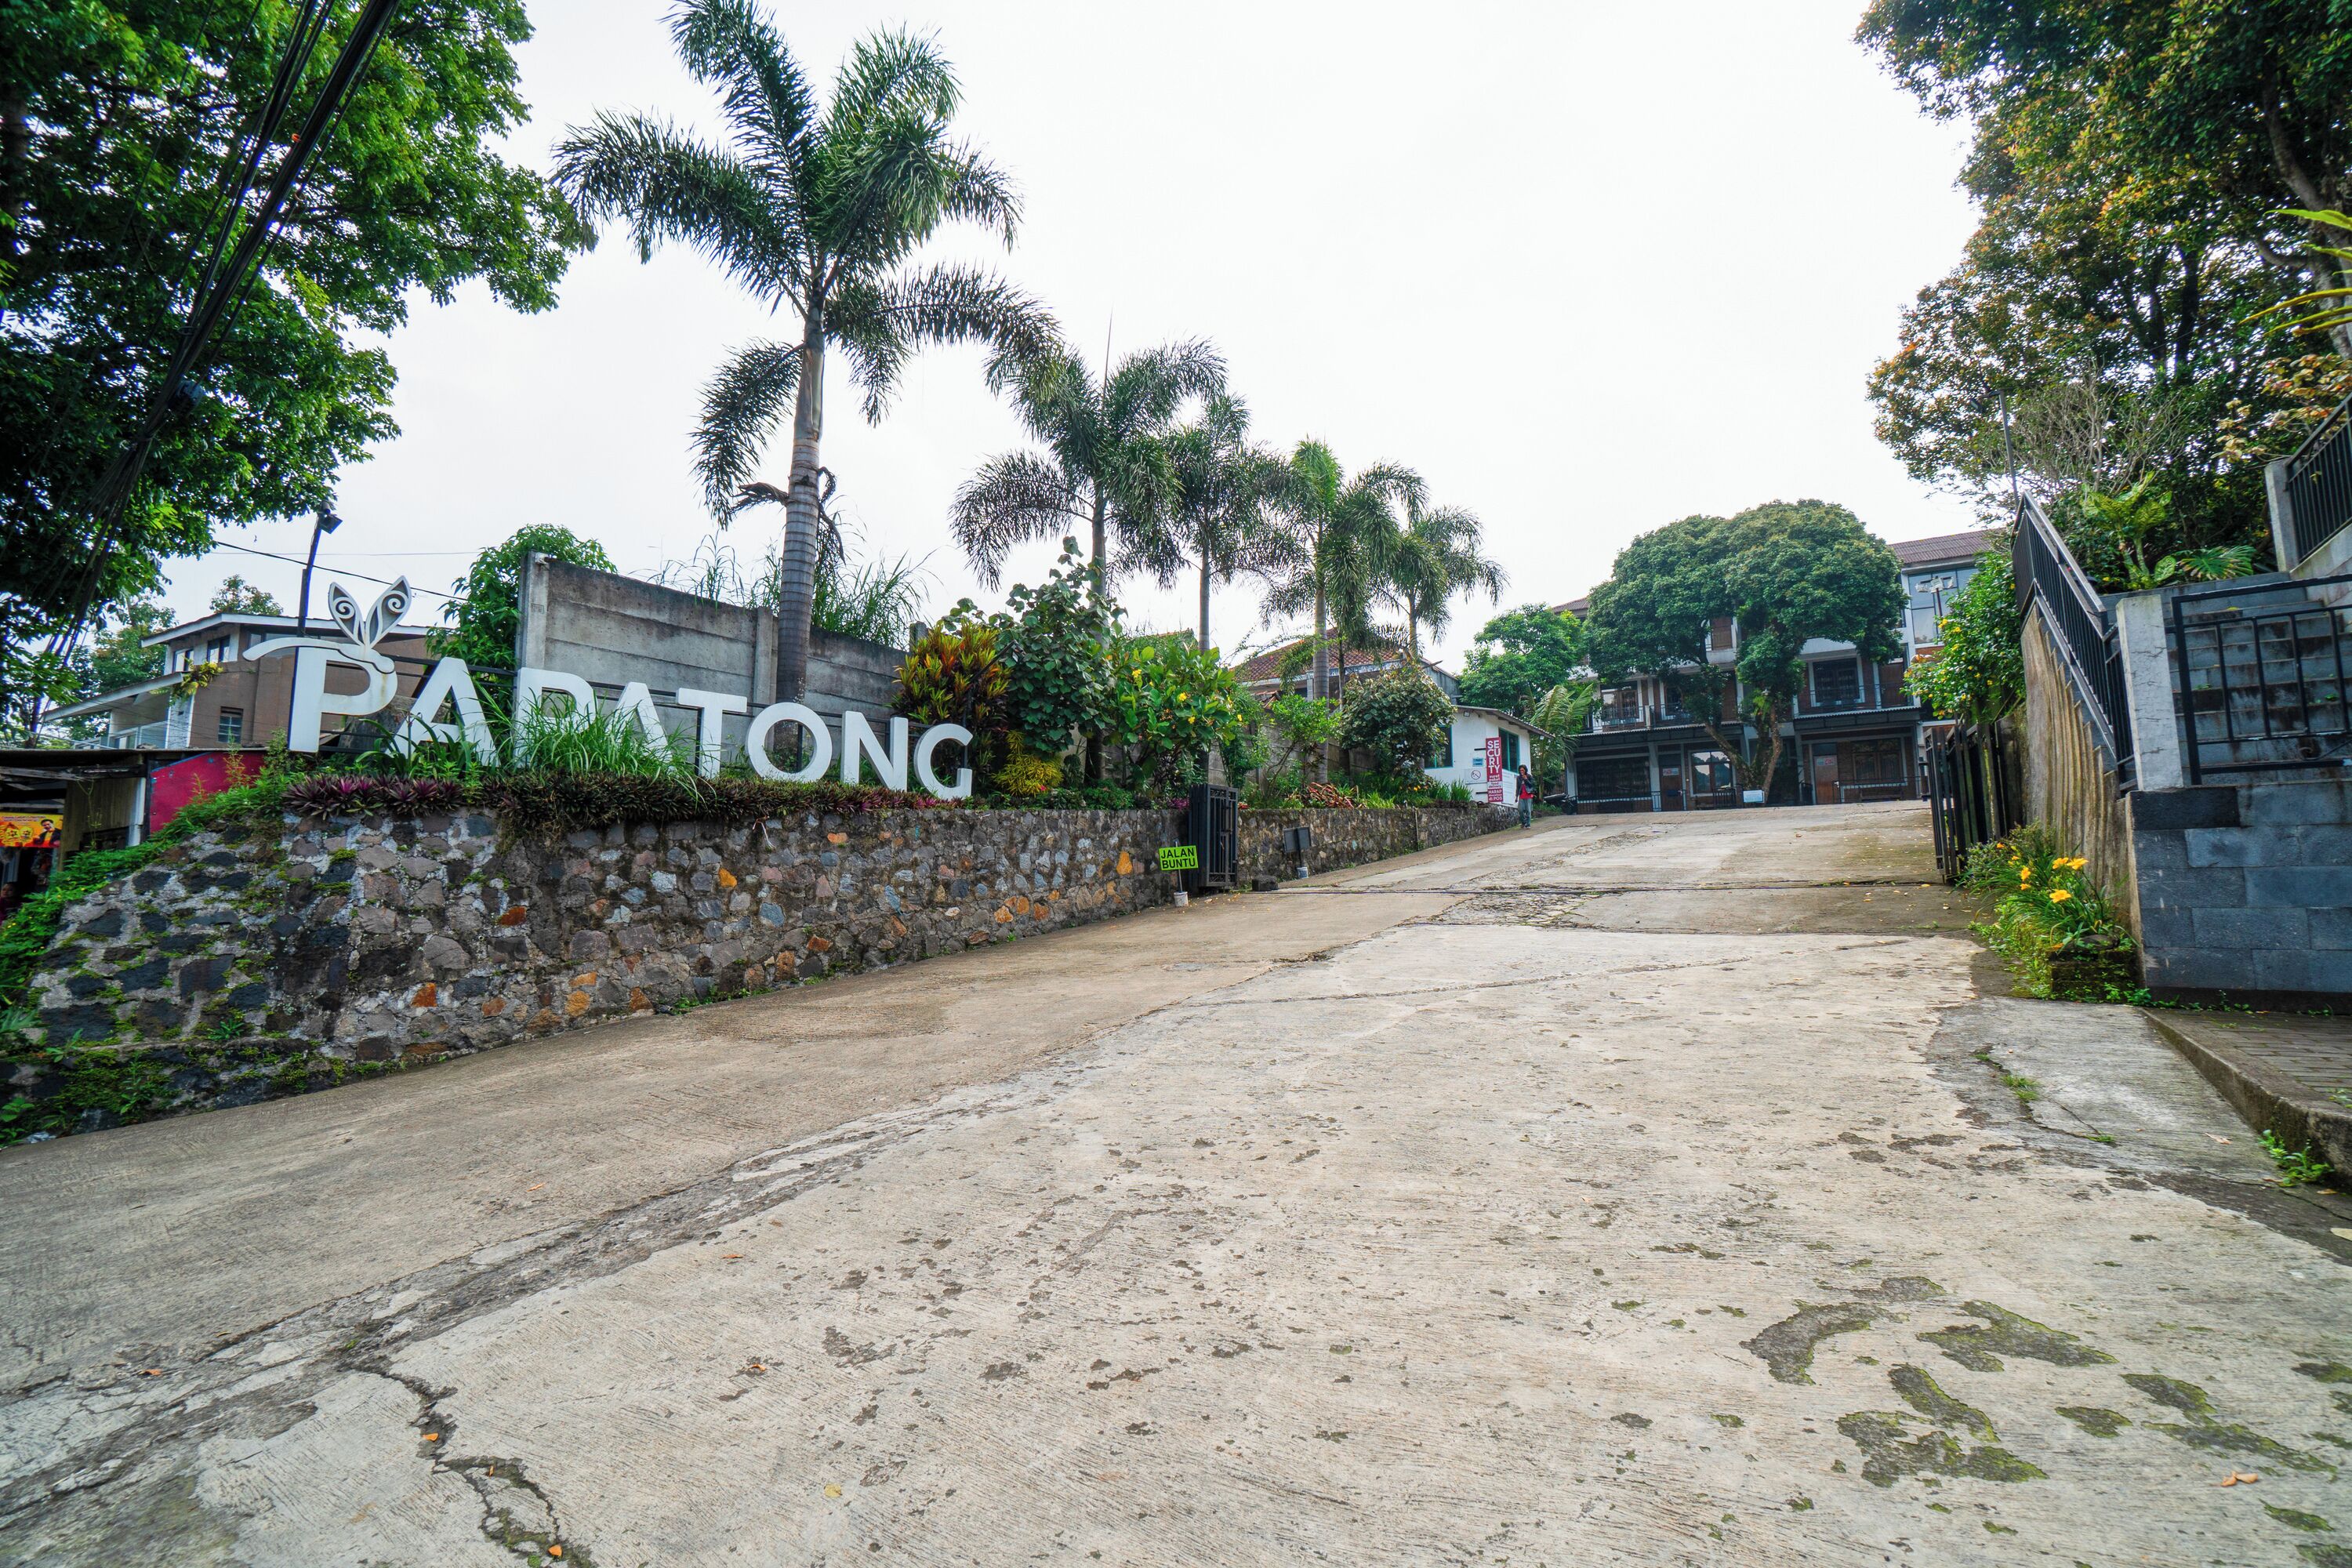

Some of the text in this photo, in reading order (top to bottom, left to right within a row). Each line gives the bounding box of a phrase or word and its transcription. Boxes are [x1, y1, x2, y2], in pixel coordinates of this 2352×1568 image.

[1487, 740, 1499, 749] SE
[1487, 749, 1501, 757] CU
[1488, 765, 1500, 774] TY
[1161, 848, 1194, 858] JALAN
[1162, 858, 1196, 869] BUNTU
